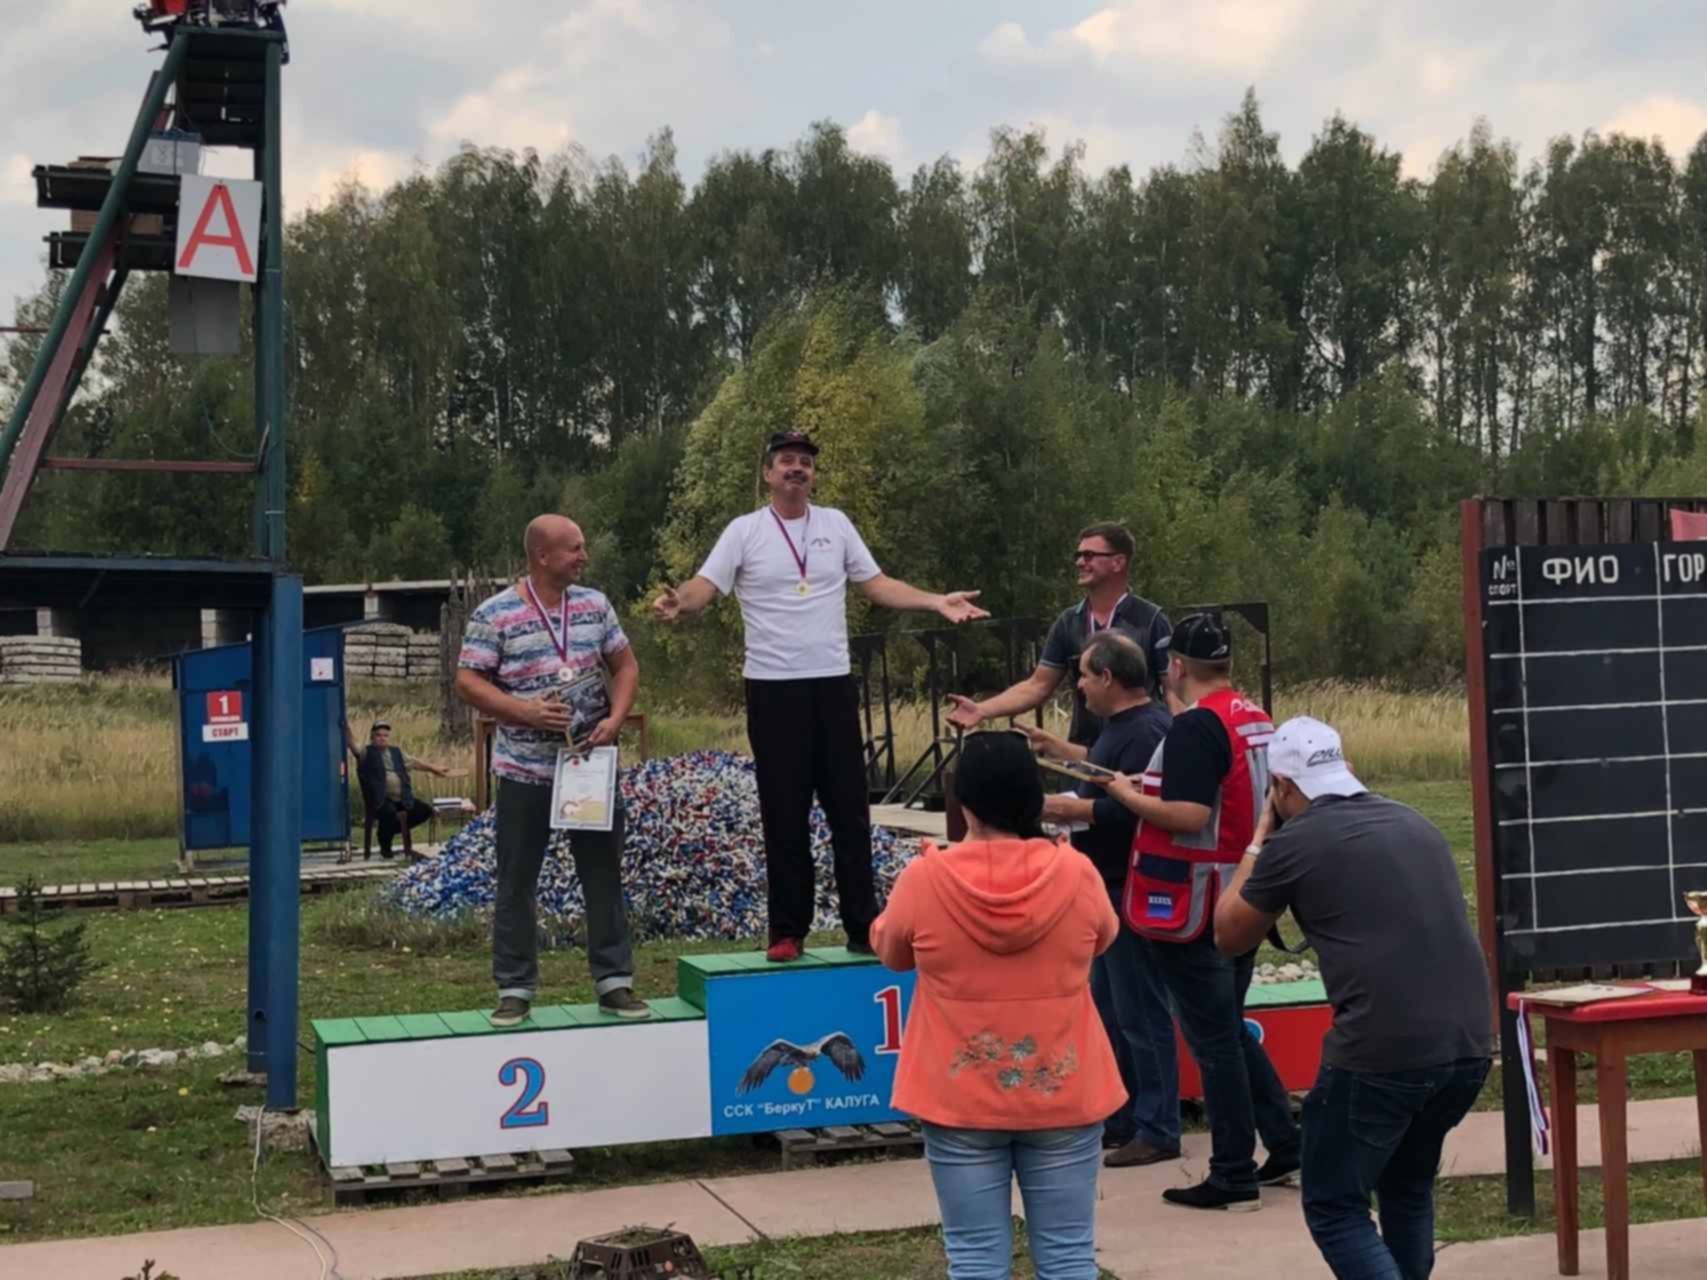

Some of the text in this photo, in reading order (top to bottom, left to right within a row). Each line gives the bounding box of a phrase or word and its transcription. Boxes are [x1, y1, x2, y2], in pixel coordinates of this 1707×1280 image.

[1542, 555, 1619, 585] ФИО
[218, 695, 229, 714] 1
[211, 726, 239, 738] СТАРТ
[873, 985, 902, 1055] 1
[498, 1057, 548, 1129] 2
[724, 1104, 754, 1117] ССК
[825, 1094, 880, 1109] КАЛУГА
